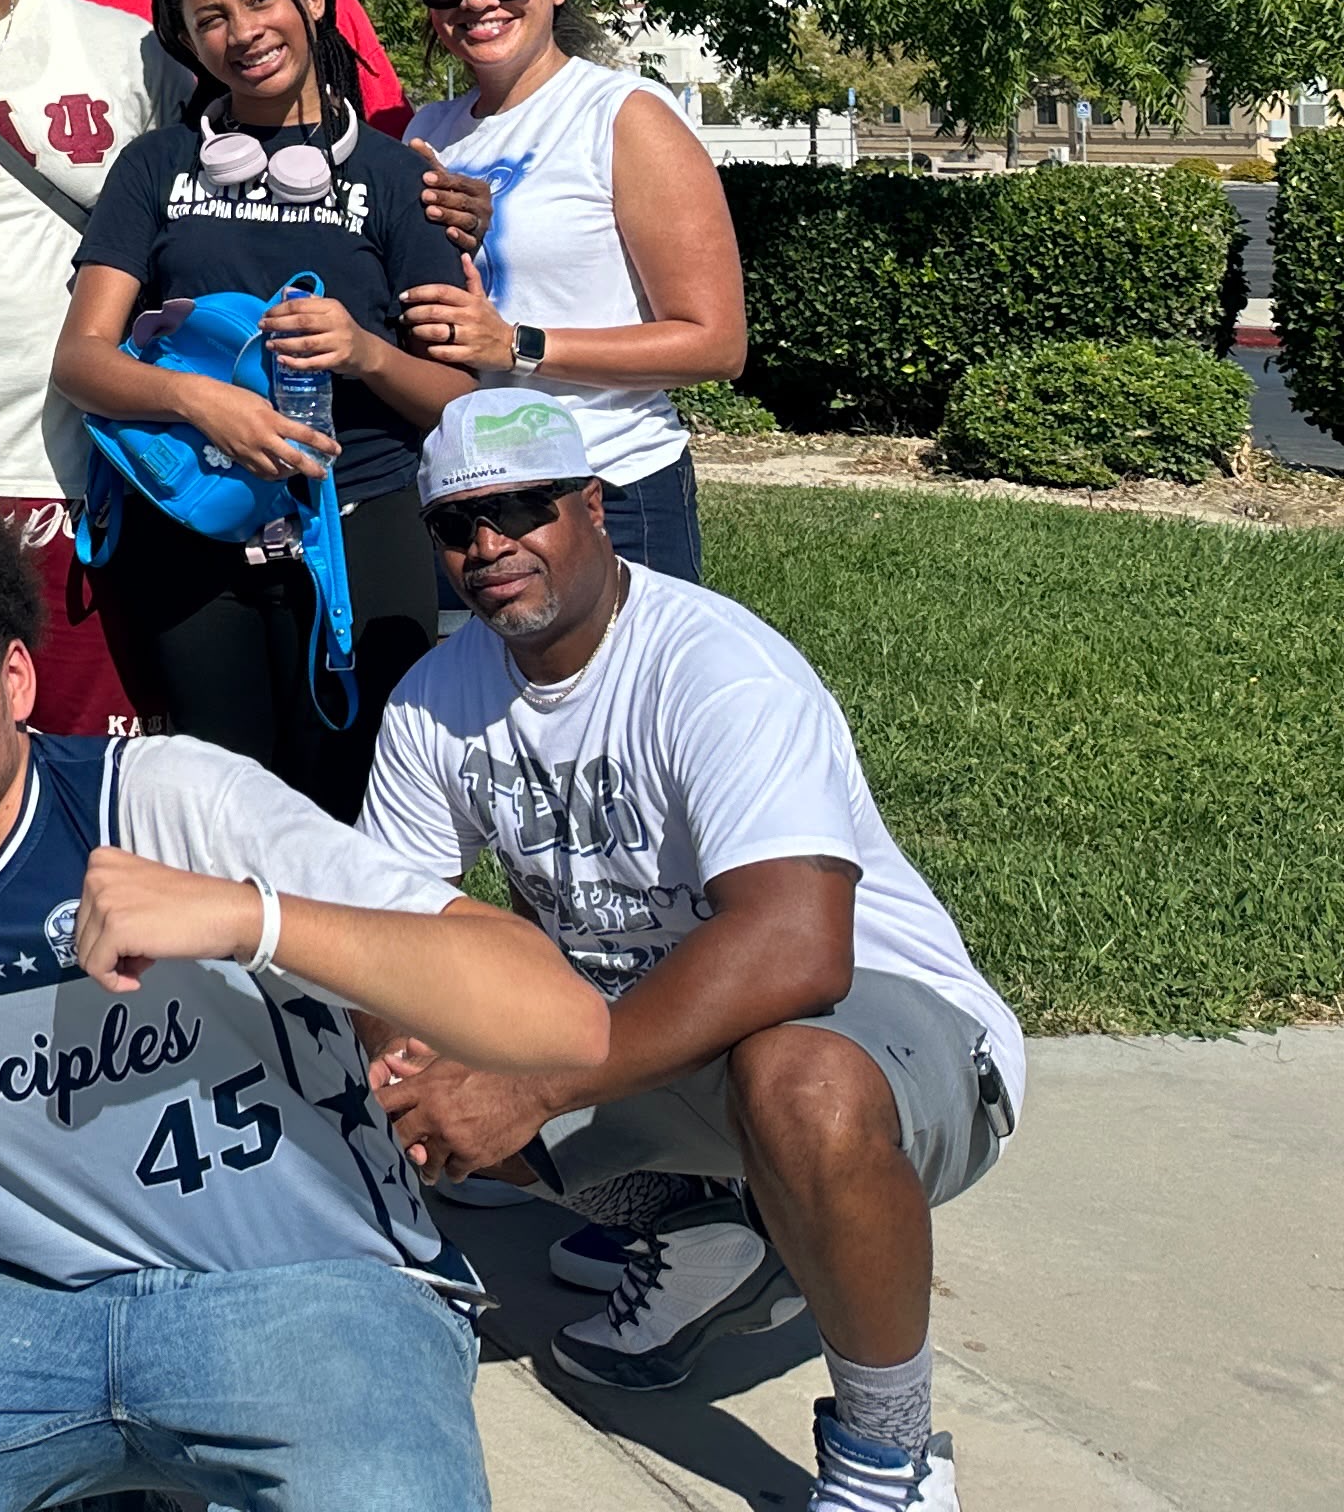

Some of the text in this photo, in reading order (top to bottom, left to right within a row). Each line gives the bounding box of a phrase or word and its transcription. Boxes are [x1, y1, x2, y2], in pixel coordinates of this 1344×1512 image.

[192, 199, 232, 219] ALPHA
[235, 202, 279, 223] GAMMA
[133, 1062, 283, 1198] 45
